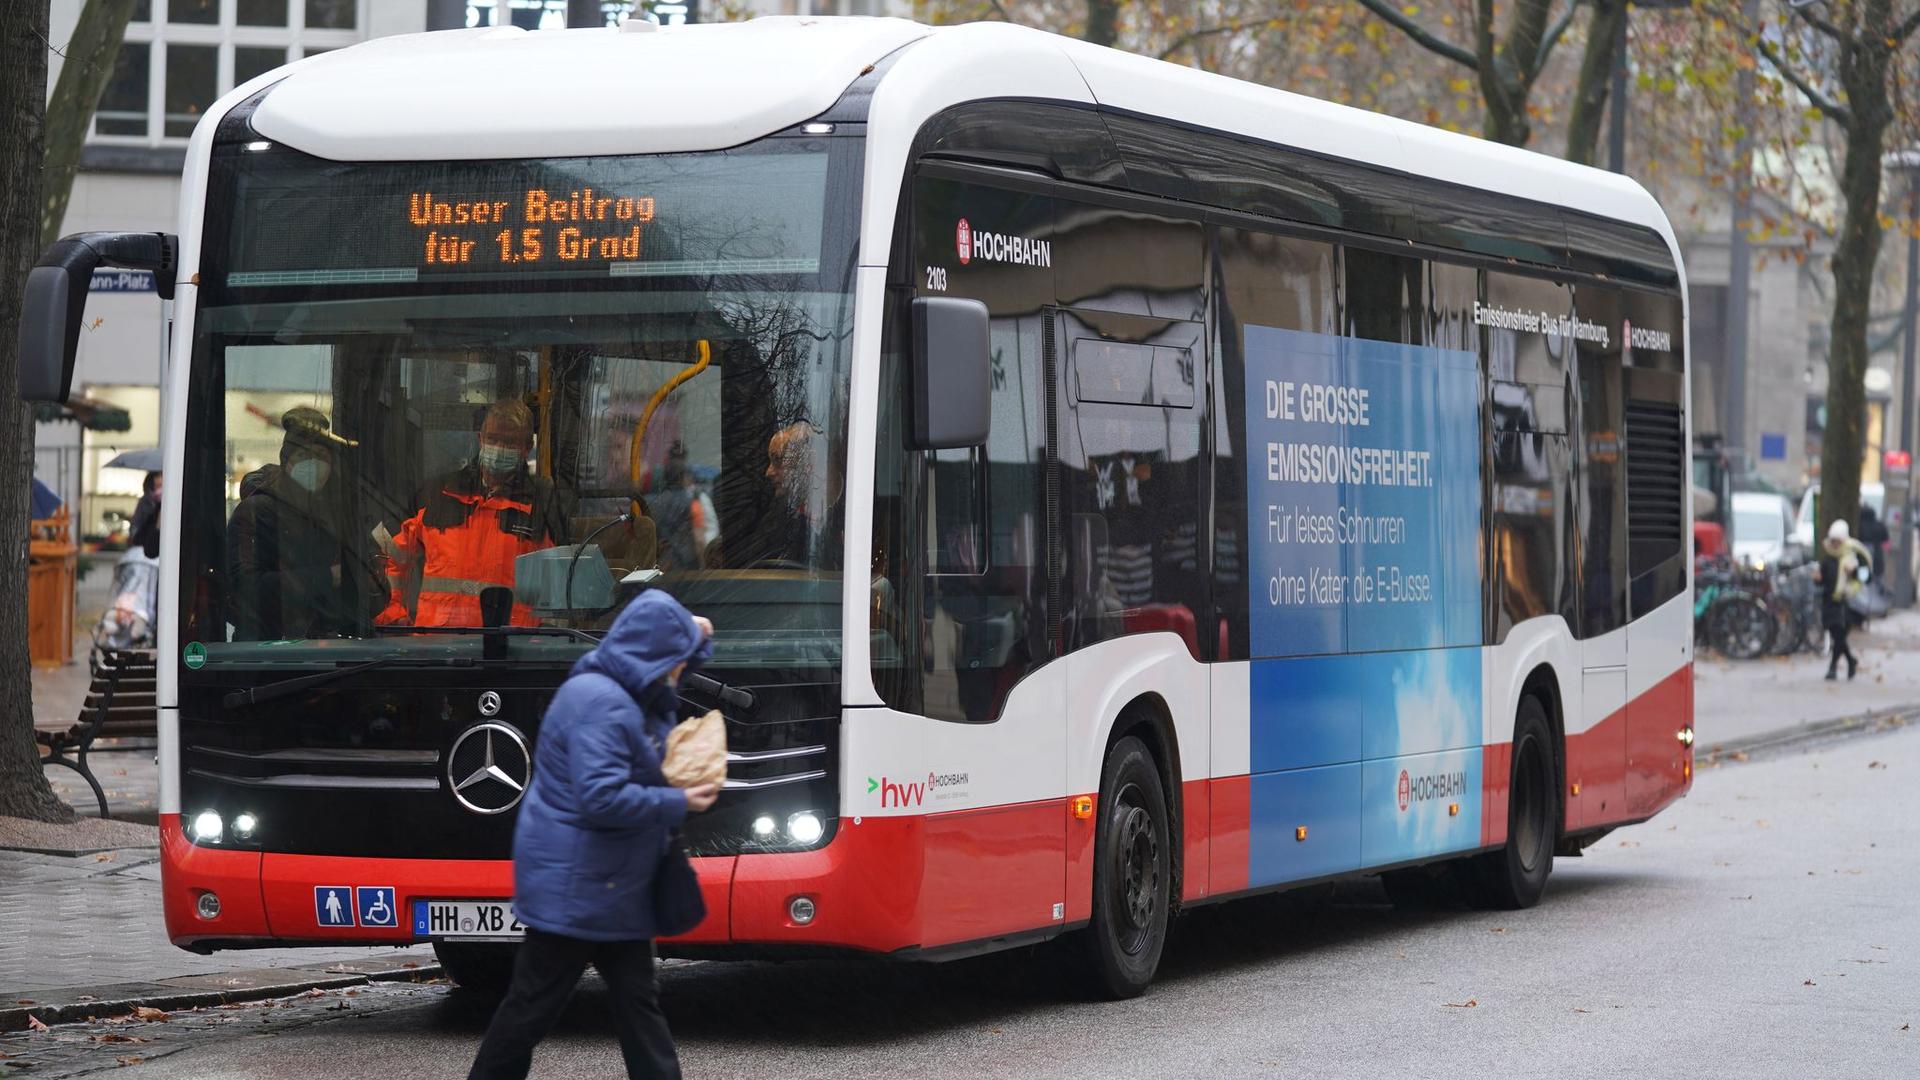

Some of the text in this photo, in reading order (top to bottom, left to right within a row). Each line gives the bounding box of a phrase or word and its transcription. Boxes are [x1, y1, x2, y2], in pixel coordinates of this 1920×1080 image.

[409, 187, 656, 225] Unser Beitrag
[426, 225, 641, 264] für 1,5 Grad
[973, 230, 1050, 267] HOCHBAHN
[926, 265, 947, 292] 2103
[1473, 300, 1610, 349] Emissionsfreier Bus für Hamburg.
[1631, 327, 1671, 352] HOCHBAHN
[1266, 380, 1370, 426] DIE GROSSE
[1267, 442, 1433, 488] EMISSIONSFREIHEIT.
[1268, 504, 1405, 545] Für leises Schnurren
[1269, 566, 1433, 606] ohne Kater: die E-Busse.
[881, 777, 925, 808] hvv
[935, 773, 968, 787] HOCHBAHN
[1411, 771, 1466, 802] HOCHBAHN
[430, 906, 458, 931] HH
[477, 906, 504, 931] XB
